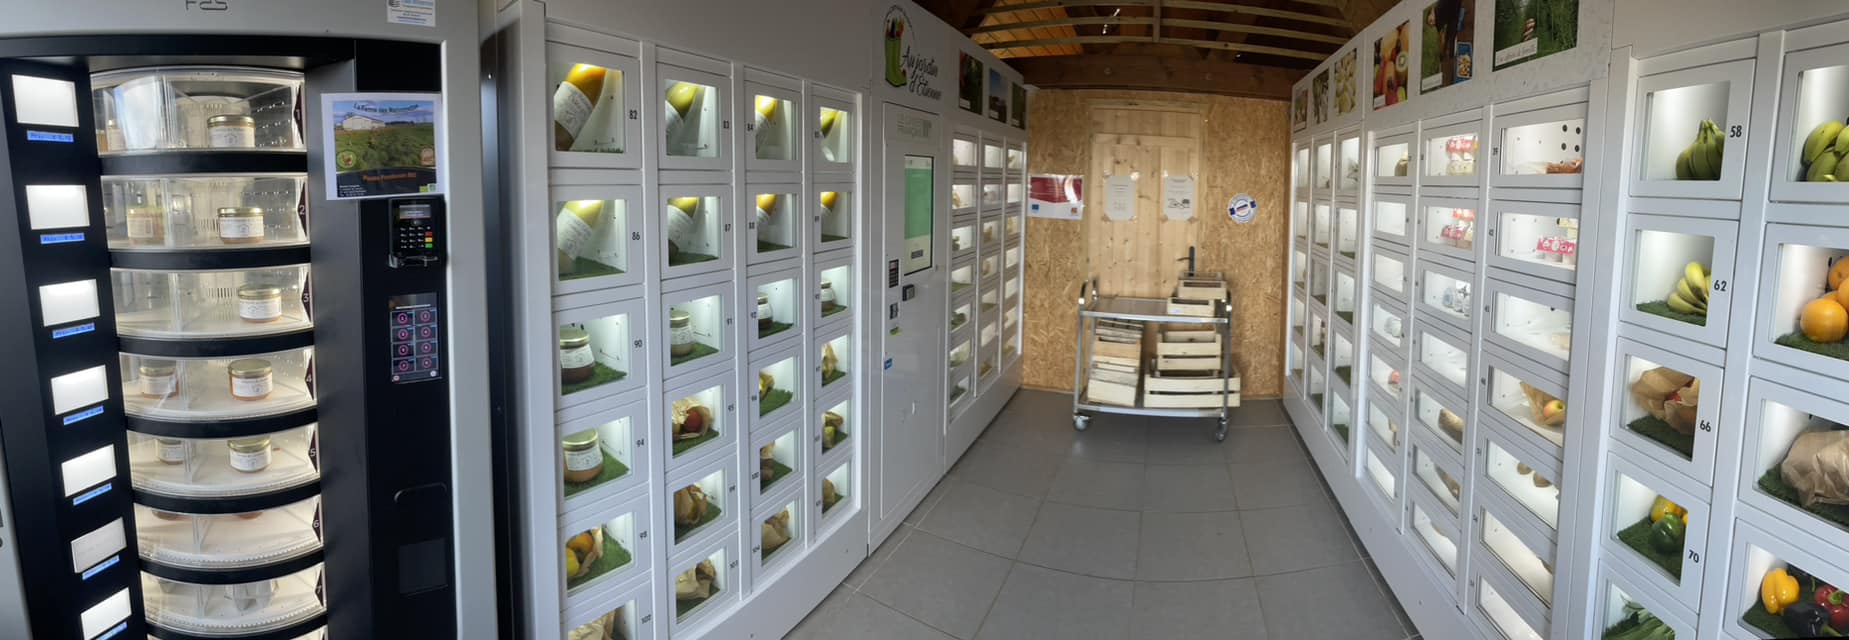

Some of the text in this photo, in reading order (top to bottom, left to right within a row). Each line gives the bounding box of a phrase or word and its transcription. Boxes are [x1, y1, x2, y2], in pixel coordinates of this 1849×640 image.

[630, 110, 638, 120] 82
[1730, 124, 1742, 138] 58
[300, 205, 305, 215] 2
[632, 232, 640, 240] 86
[1714, 280, 1727, 292] 62
[304, 293, 309, 302] 3
[634, 340, 642, 348] 90
[1700, 420, 1712, 432] 66
[636, 438, 644, 448] 94
[313, 520, 320, 528] 6
[1688, 550, 1700, 564] 70
[316, 586, 322, 594] 7
